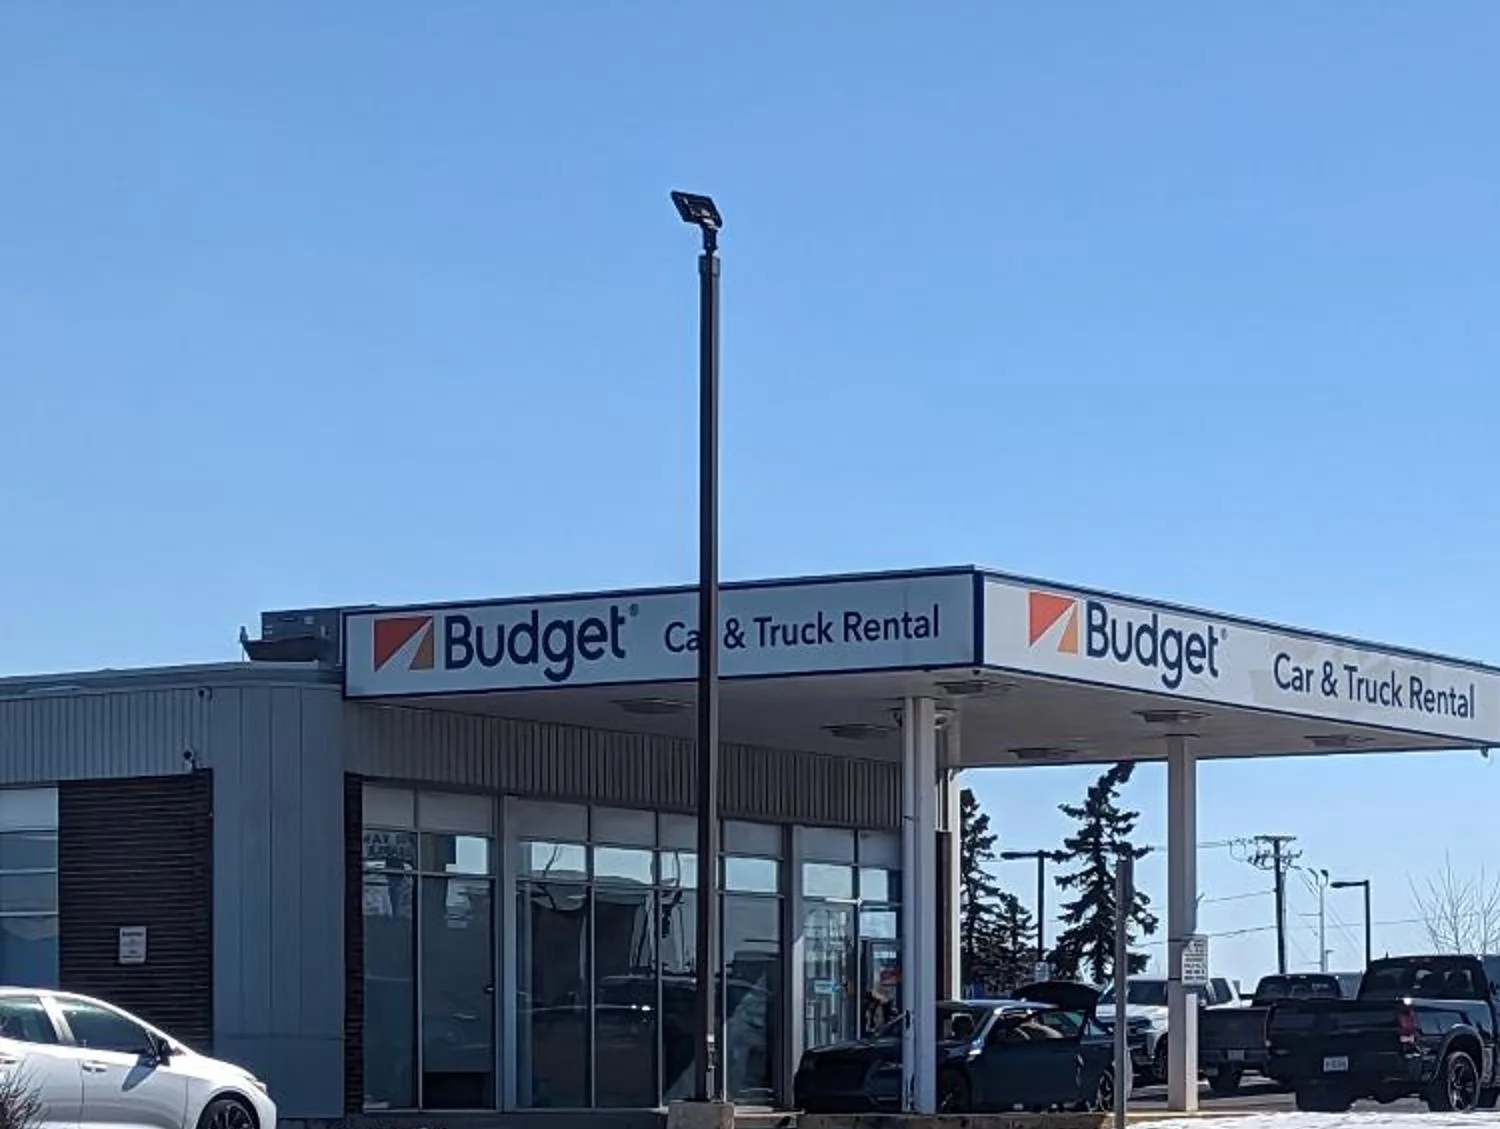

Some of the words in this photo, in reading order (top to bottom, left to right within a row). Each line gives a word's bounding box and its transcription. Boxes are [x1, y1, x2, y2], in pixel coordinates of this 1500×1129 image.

[444, 605, 627, 684] Budget
[664, 621, 702, 653] Ca
[723, 617, 746, 649] &
[754, 611, 835, 649] Truck
[842, 604, 940, 642] Rental
[1086, 601, 1219, 690] Budget
[1273, 652, 1313, 694] Car
[1320, 660, 1339, 698] &
[1343, 664, 1403, 709] Truck
[1409, 676, 1476, 720] Rental
